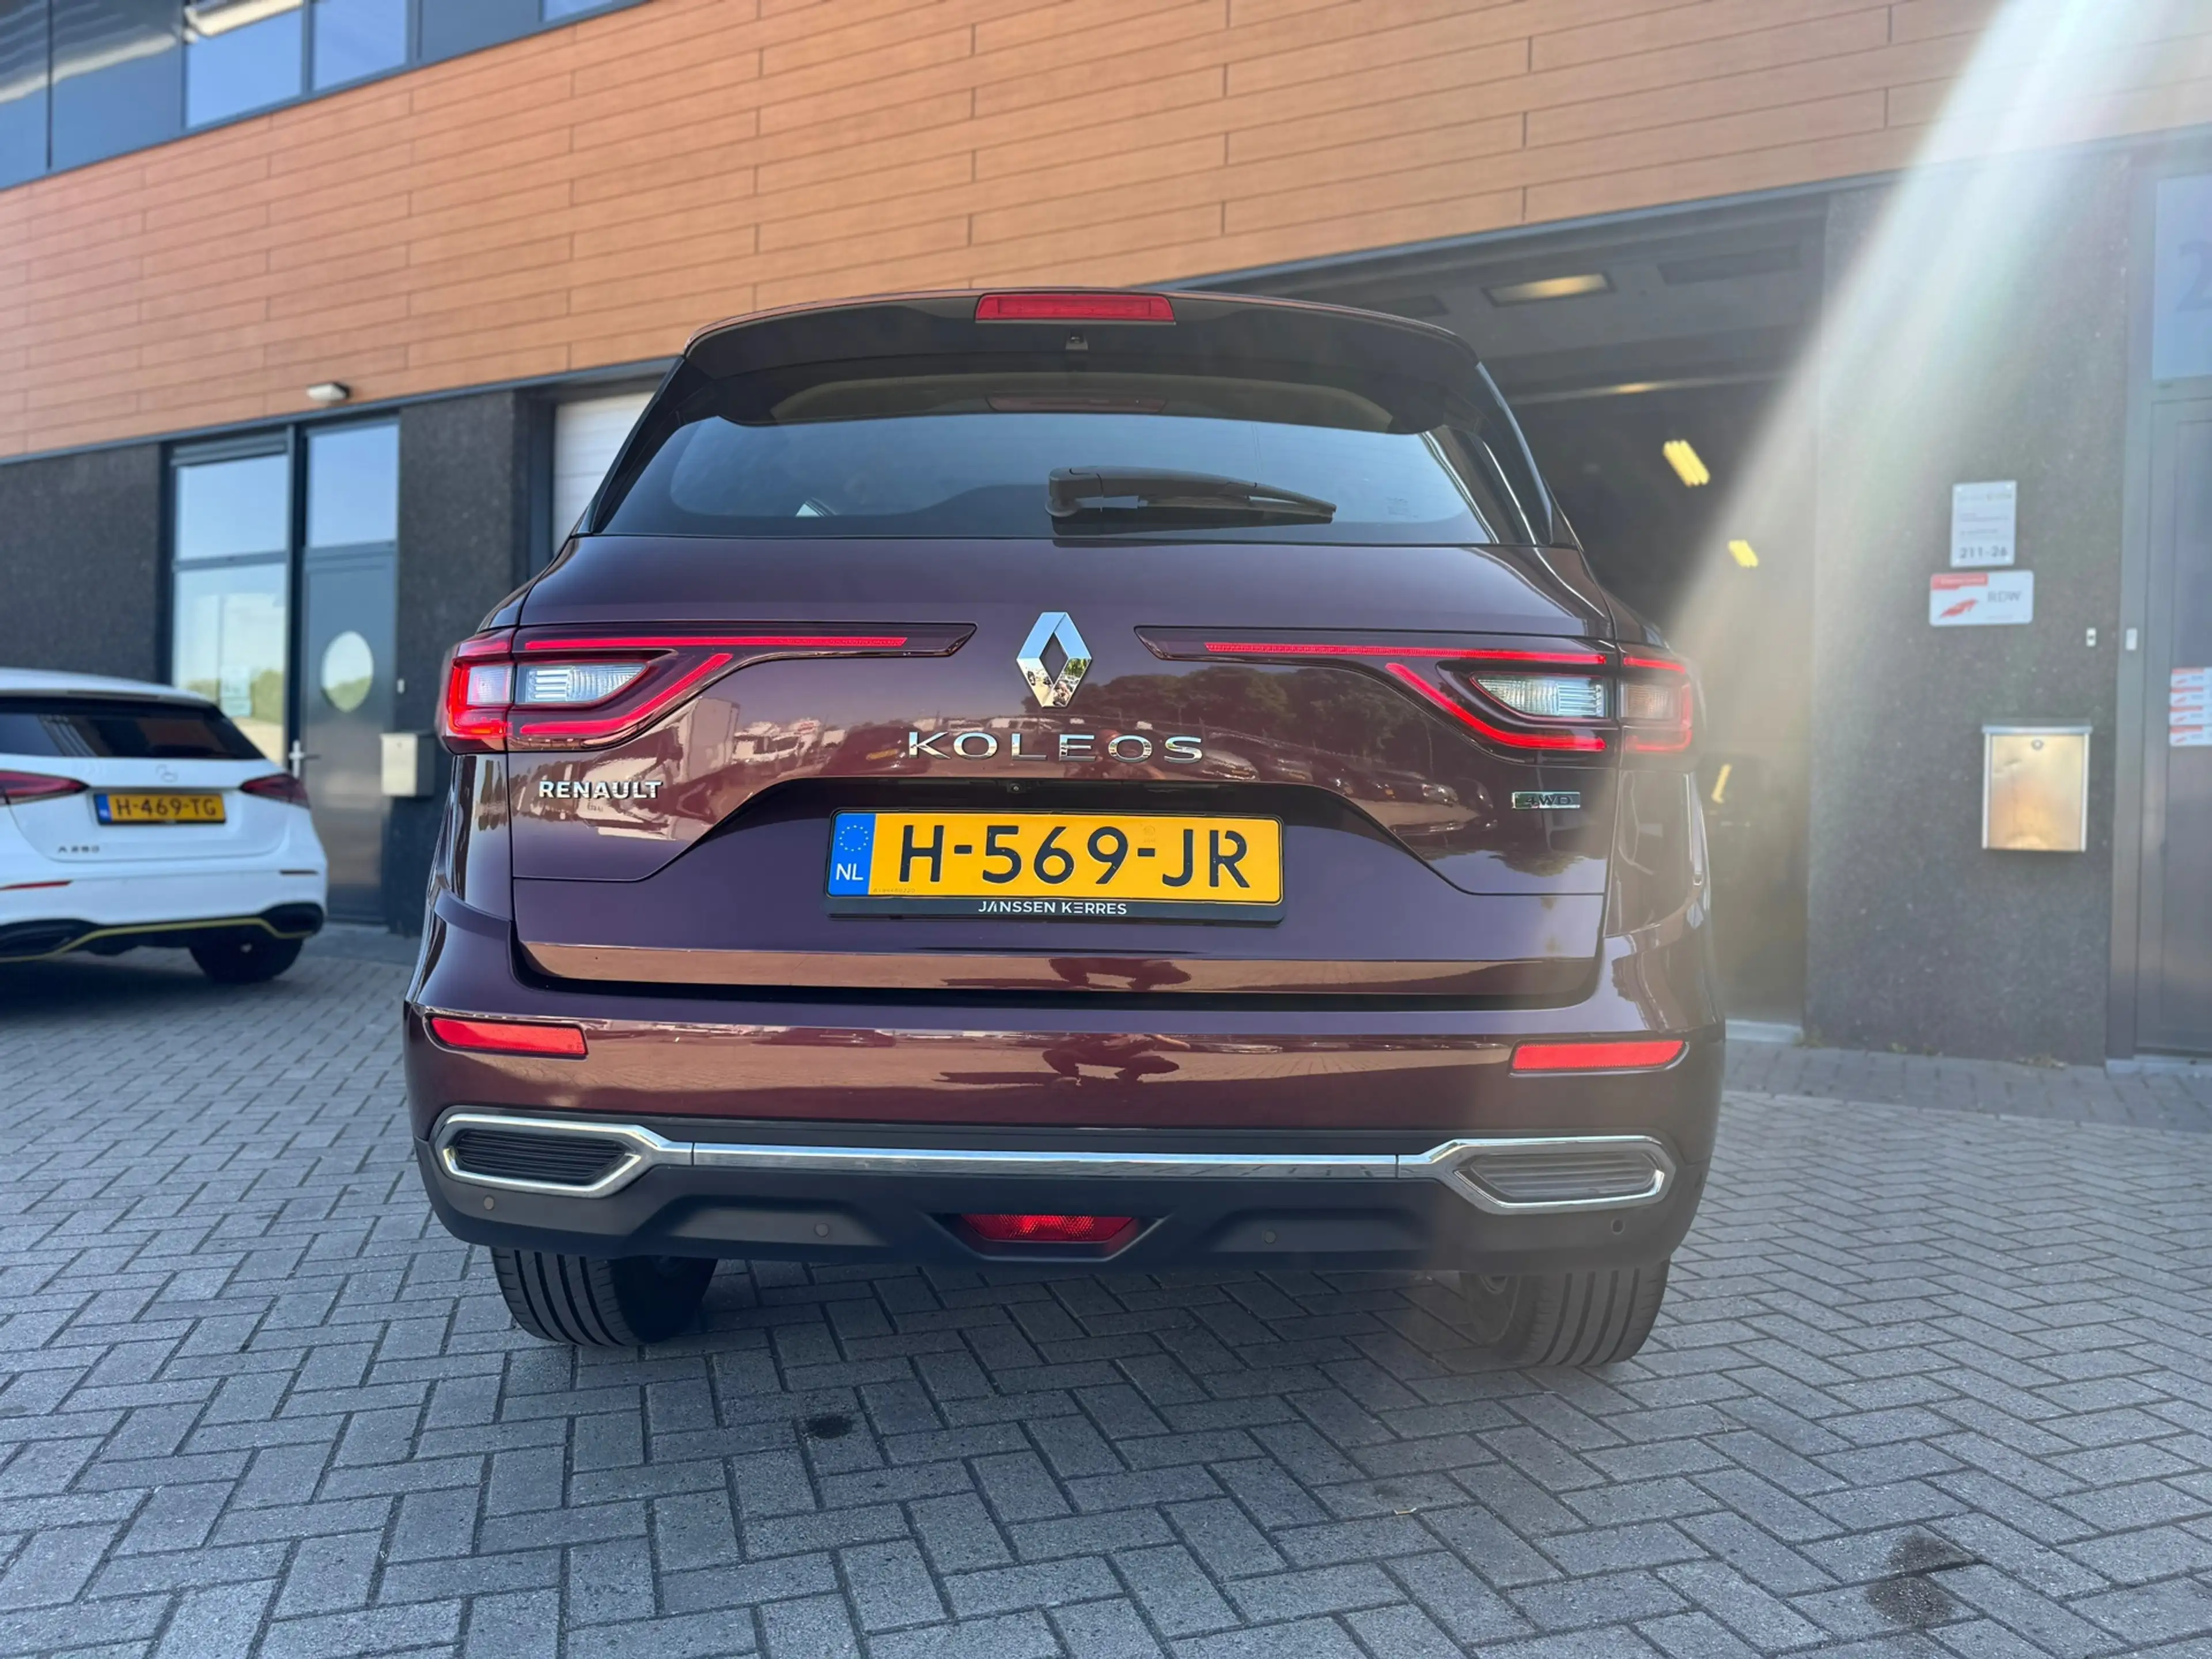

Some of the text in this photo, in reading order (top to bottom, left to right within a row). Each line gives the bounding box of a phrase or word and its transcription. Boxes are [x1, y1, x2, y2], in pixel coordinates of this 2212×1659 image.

[908, 731, 1203, 764] KOLEOS
[539, 781, 662, 798] RENAULT
[116, 797, 215, 816] H-469-TG
[1525, 794, 1572, 806] 4WD
[899, 825, 1251, 888] H-569-JR
[836, 863, 863, 881] NL
[979, 901, 1127, 915] JANSSEN KERRES
